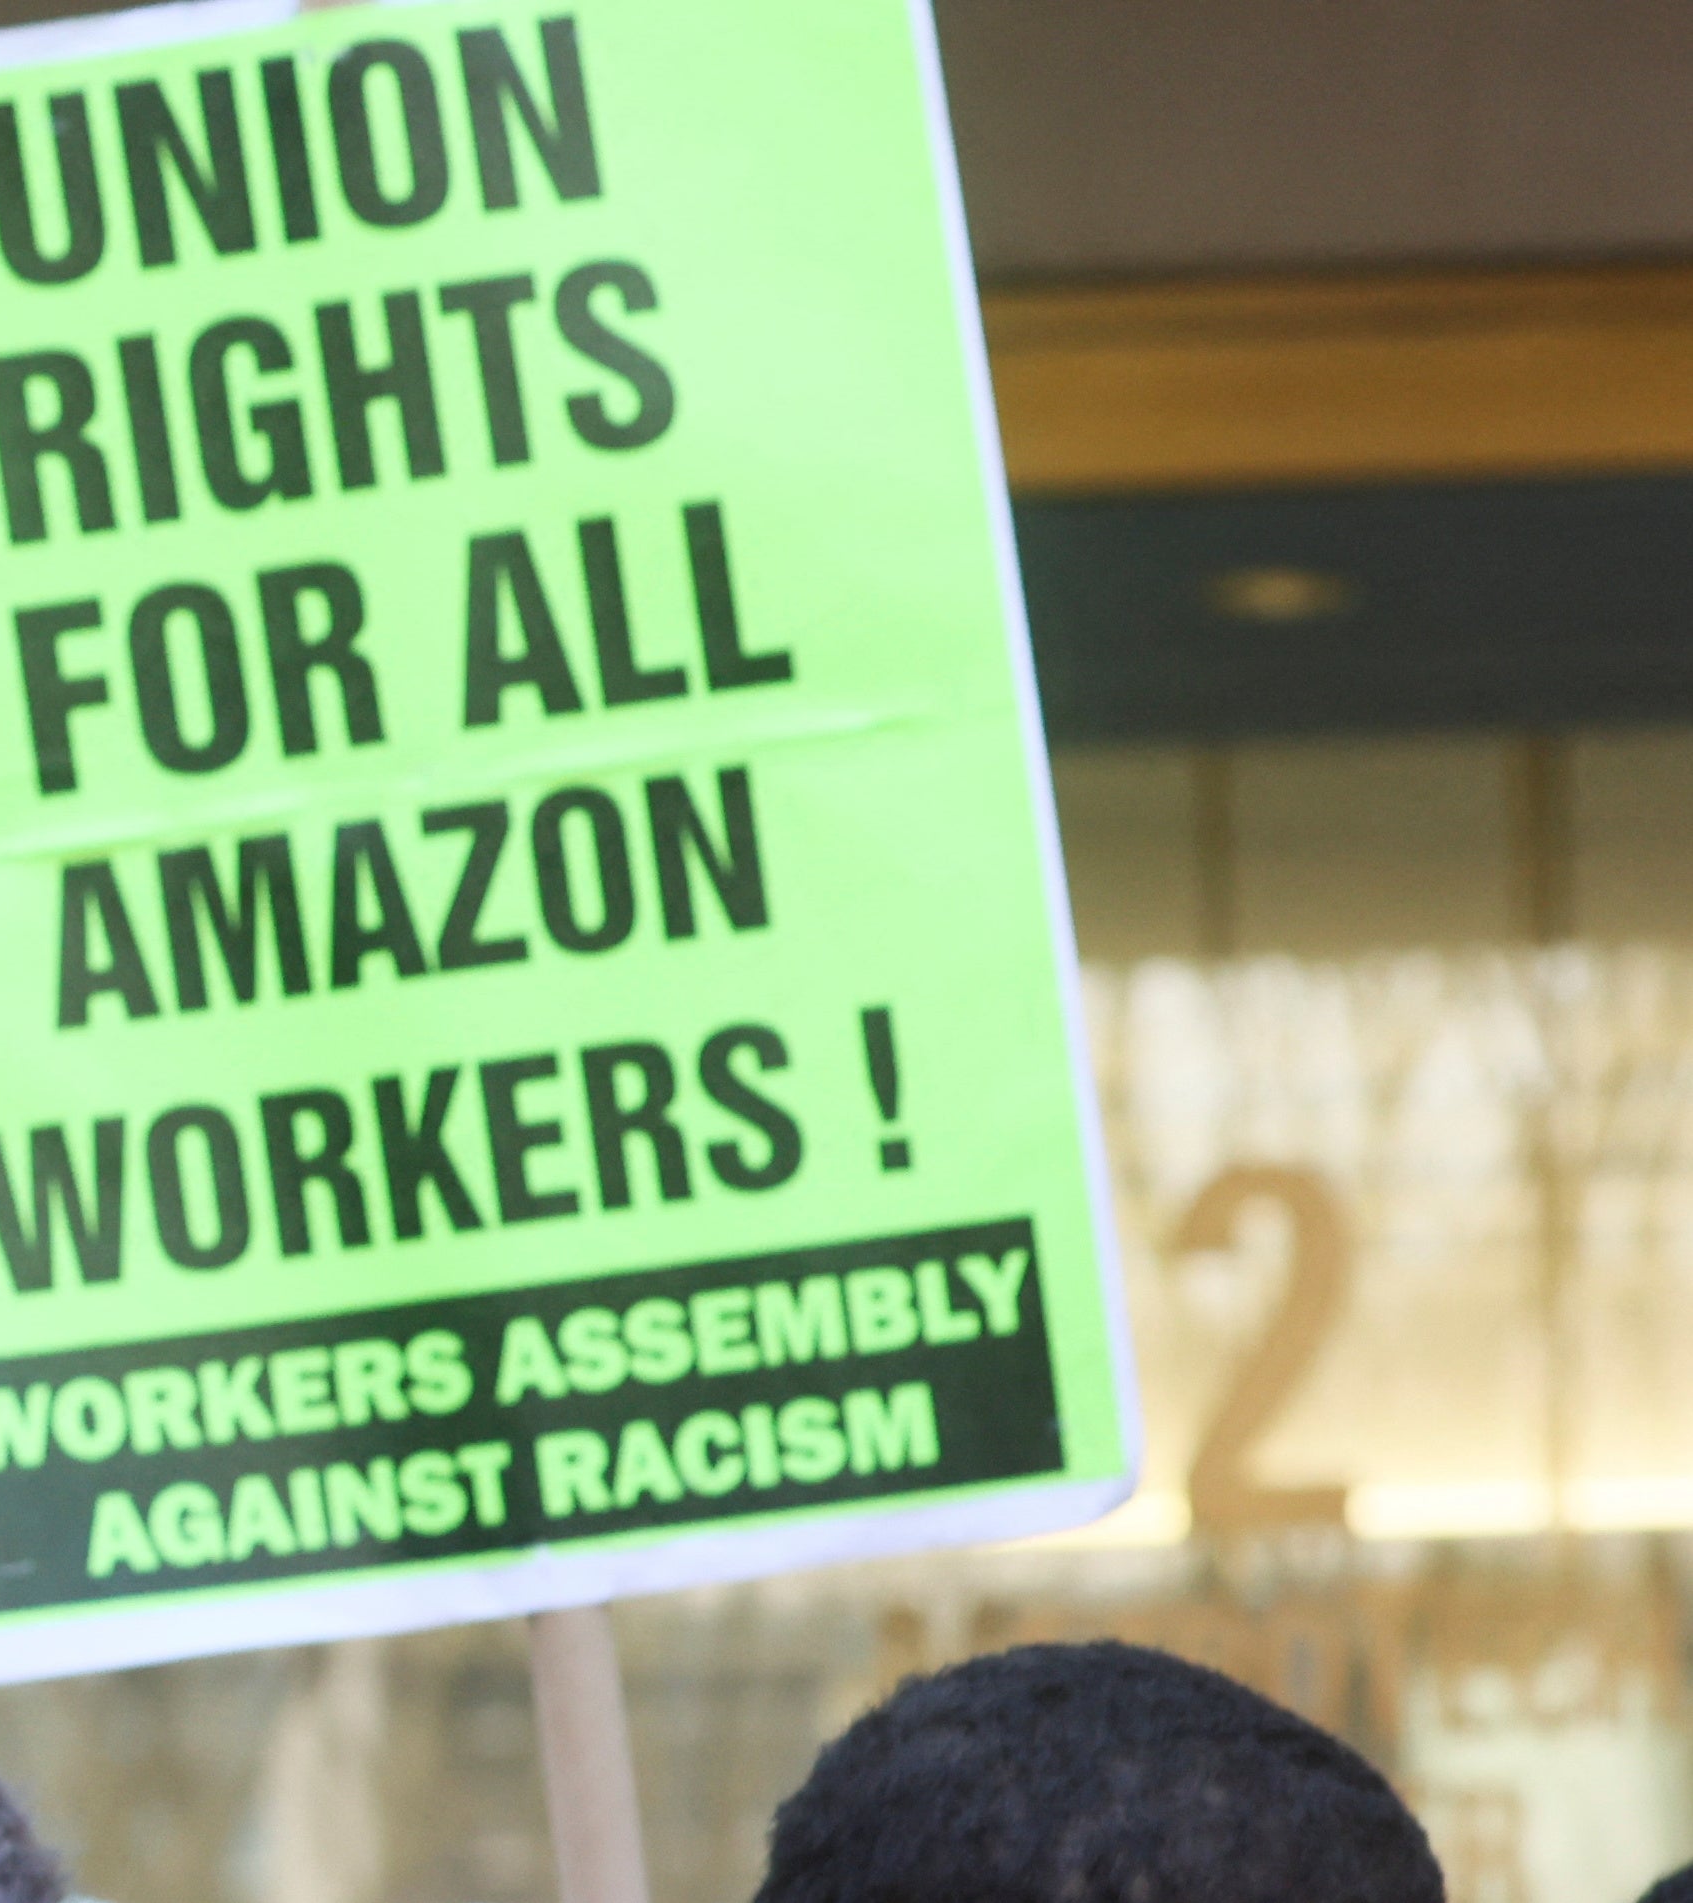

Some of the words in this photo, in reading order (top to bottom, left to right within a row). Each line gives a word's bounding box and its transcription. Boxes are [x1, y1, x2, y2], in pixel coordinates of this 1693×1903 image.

[15, 562, 384, 795] FOR
[464, 502, 793, 727] ALL
[56, 766, 770, 1029] AMAZON
[494, 1250, 1029, 1403] ASSEMBLY
[87, 1442, 510, 1579] AGAINST
[534, 1384, 938, 1514] RACISM
